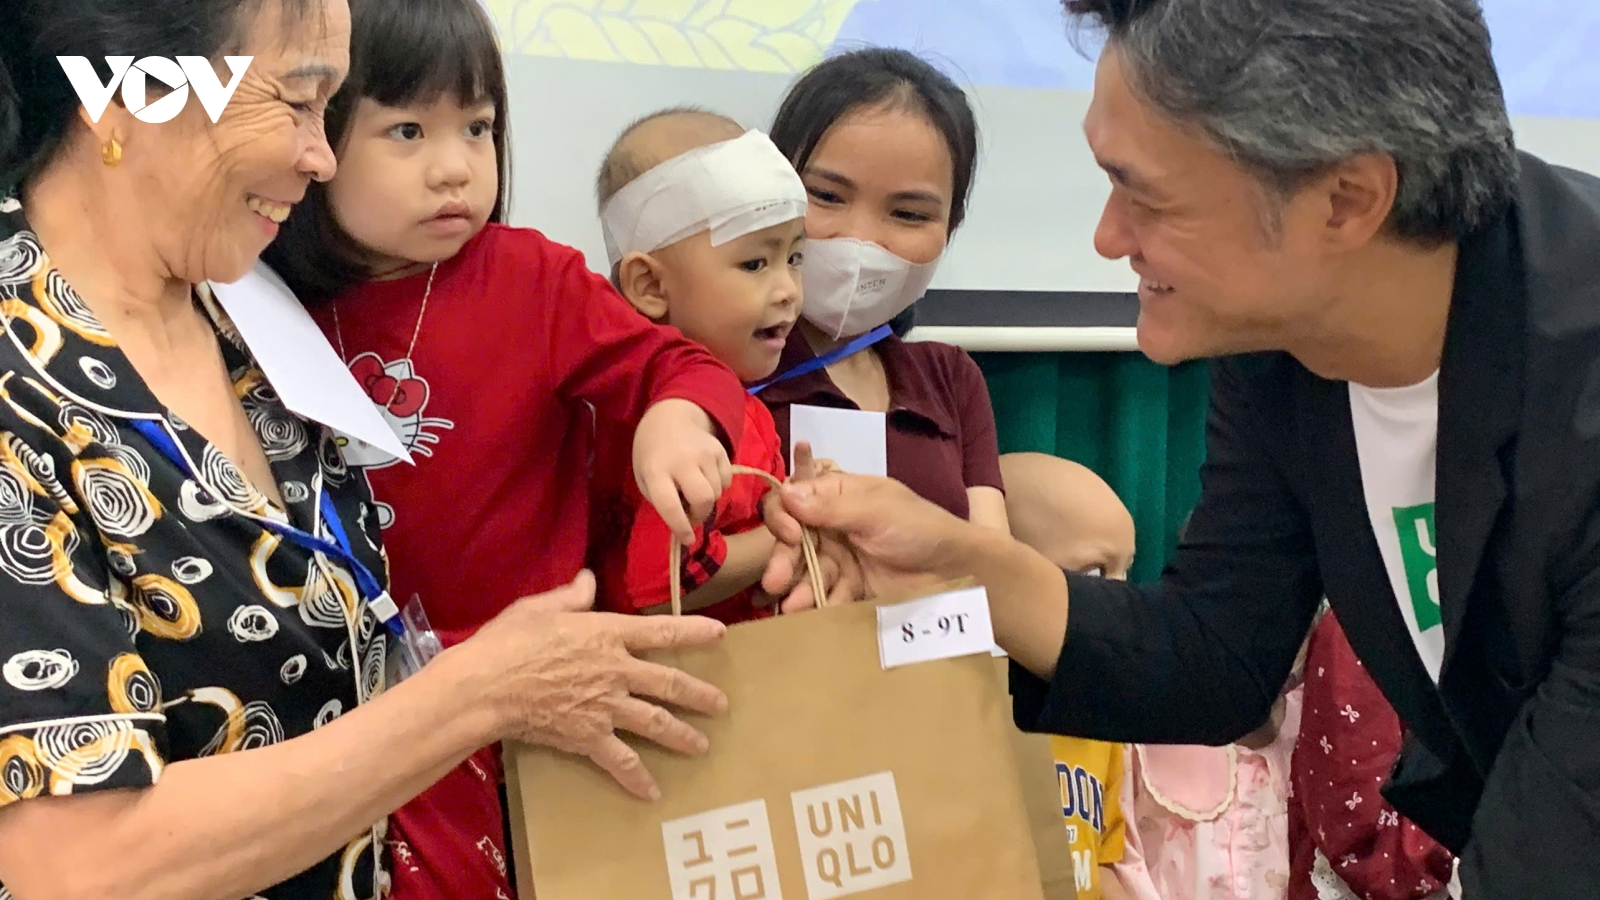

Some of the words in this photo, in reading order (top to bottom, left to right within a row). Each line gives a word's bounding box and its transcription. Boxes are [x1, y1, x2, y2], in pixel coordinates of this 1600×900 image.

[901, 621, 915, 644] 8
[937, 612, 970, 636] 9T
[807, 790, 882, 838] UNI
[816, 835, 896, 888] QLO
